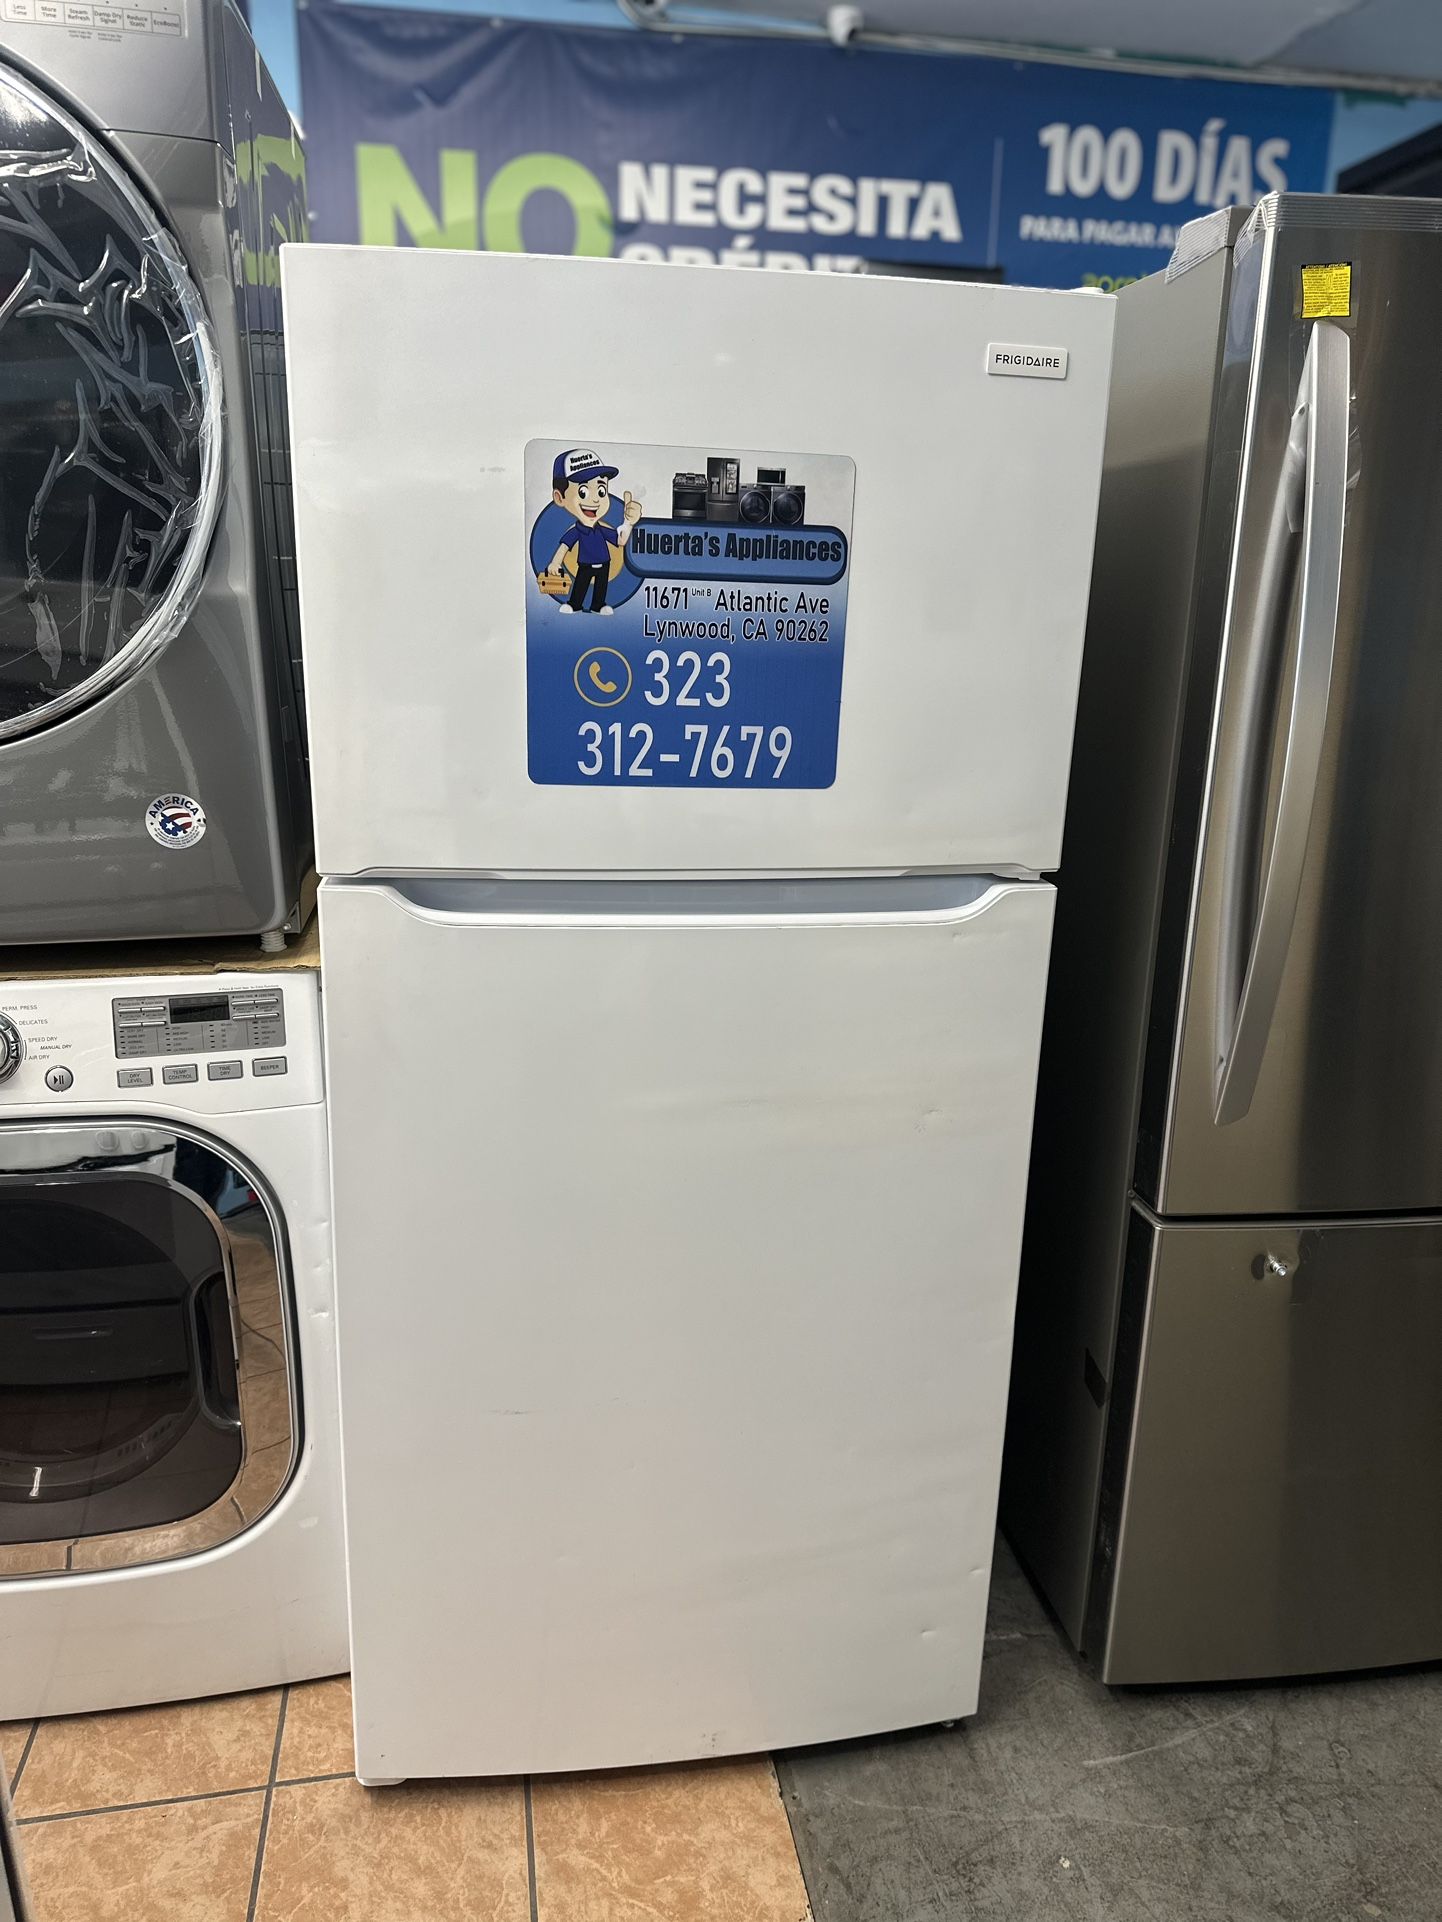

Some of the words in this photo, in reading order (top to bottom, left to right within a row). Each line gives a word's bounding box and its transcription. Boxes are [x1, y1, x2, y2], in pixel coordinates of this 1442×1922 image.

[1038, 123, 1143, 201] 100
[1153, 117, 1291, 206] DÍAS
[356, 143, 613, 257] NO
[618, 162, 963, 243] NECESITA
[1019, 215, 1080, 243] PARA
[1081, 218, 1157, 248] PAGAR
[995, 354, 1060, 368] FRIGIDAIRE
[570, 453, 593, 464] Huerta's
[570, 460, 600, 471] Appliances
[632, 529, 720, 557] Huerta's
[725, 532, 842, 562] Appliances
[644, 587, 688, 609] 11671
[692, 588, 705, 597] Unit
[714, 589, 789, 613] Atlantic
[794, 592, 830, 615] Ave
[644, 615, 736, 643] Lynwood,
[742, 618, 768, 640] CA
[775, 619, 829, 642] 90262
[644, 650, 731, 708] 323
[577, 721, 793, 779] 312-7679
[149, 796, 199, 819] AMERICA
